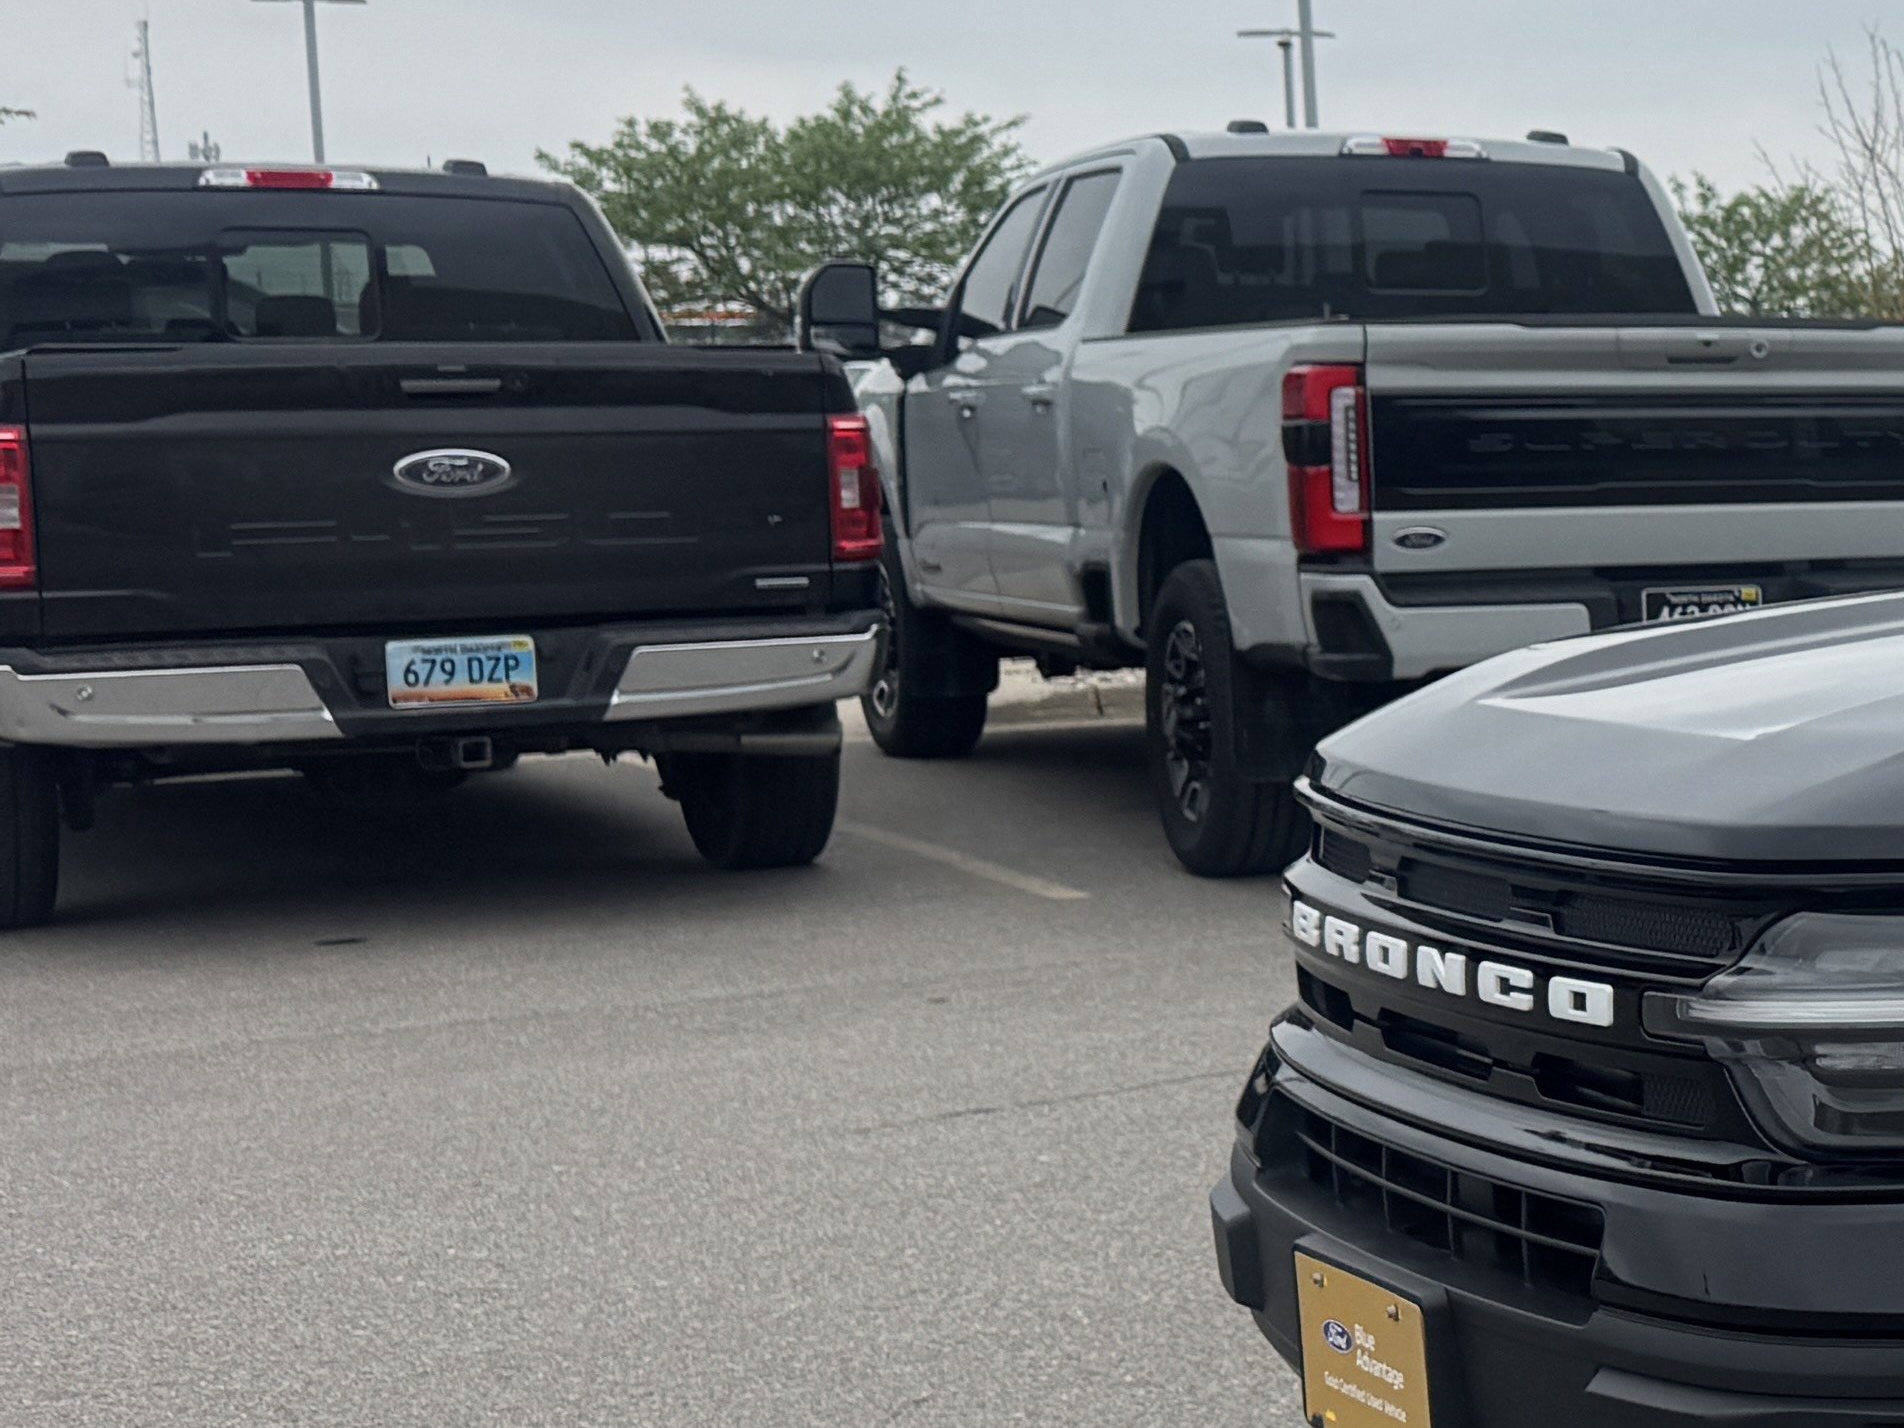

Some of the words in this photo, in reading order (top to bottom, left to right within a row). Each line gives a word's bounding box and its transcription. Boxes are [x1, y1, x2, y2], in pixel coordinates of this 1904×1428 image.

[403, 657, 456, 688] 679
[466, 653, 520, 684] DZP
[1292, 900, 1615, 1028] BRONCO
[1354, 1322, 1376, 1352] Blue
[1356, 1348, 1405, 1391] Advantage
